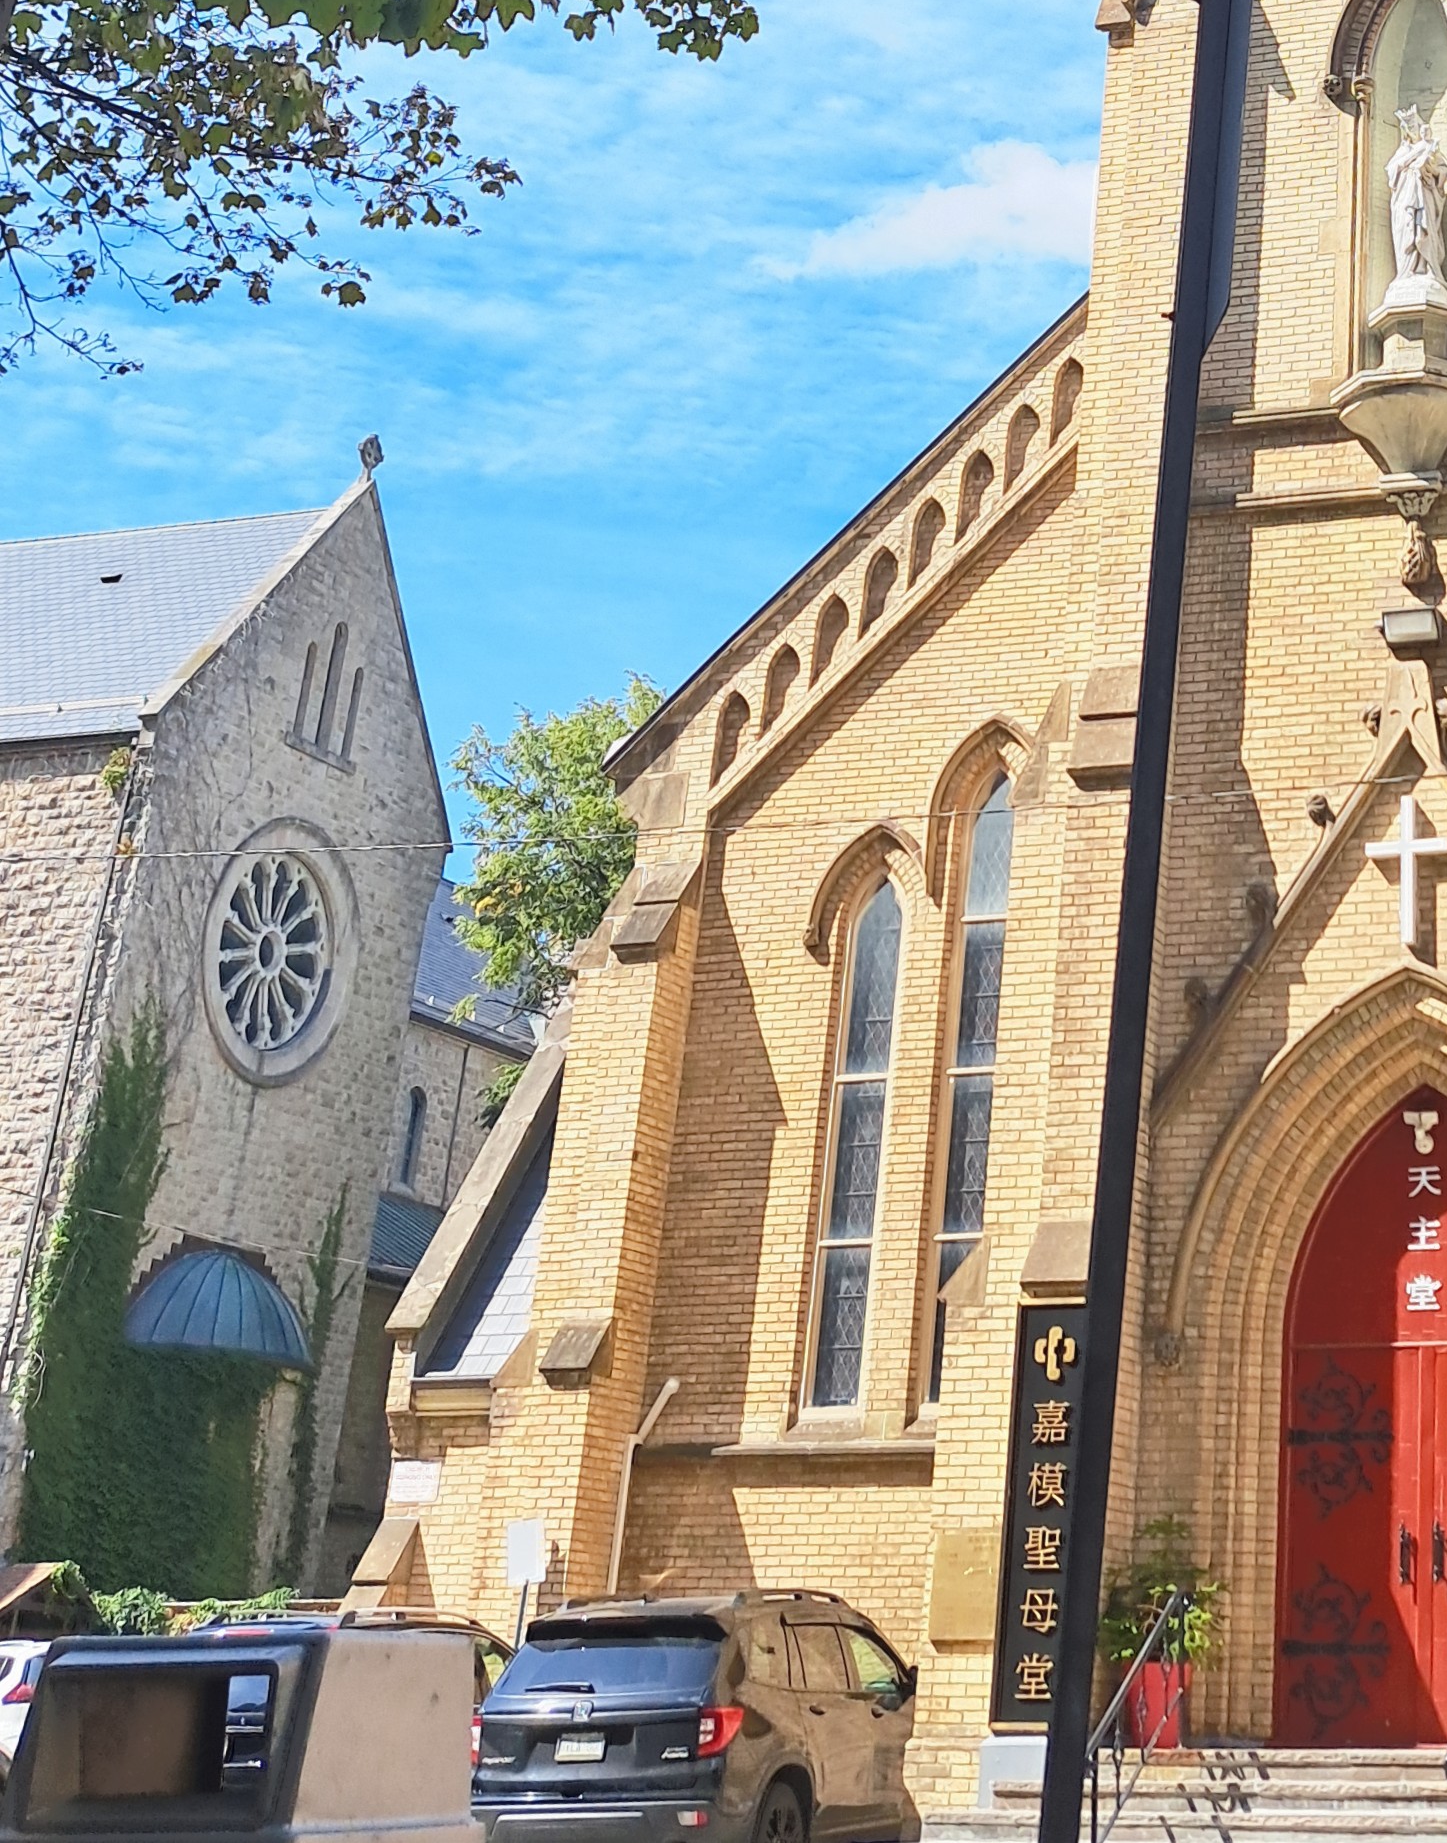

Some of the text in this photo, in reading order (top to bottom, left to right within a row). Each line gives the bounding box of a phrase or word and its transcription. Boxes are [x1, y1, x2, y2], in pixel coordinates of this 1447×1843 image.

[1406, 1165, 1442, 1311] 天主堂
[1015, 1399, 1069, 1700] 嘉模聖母堂
